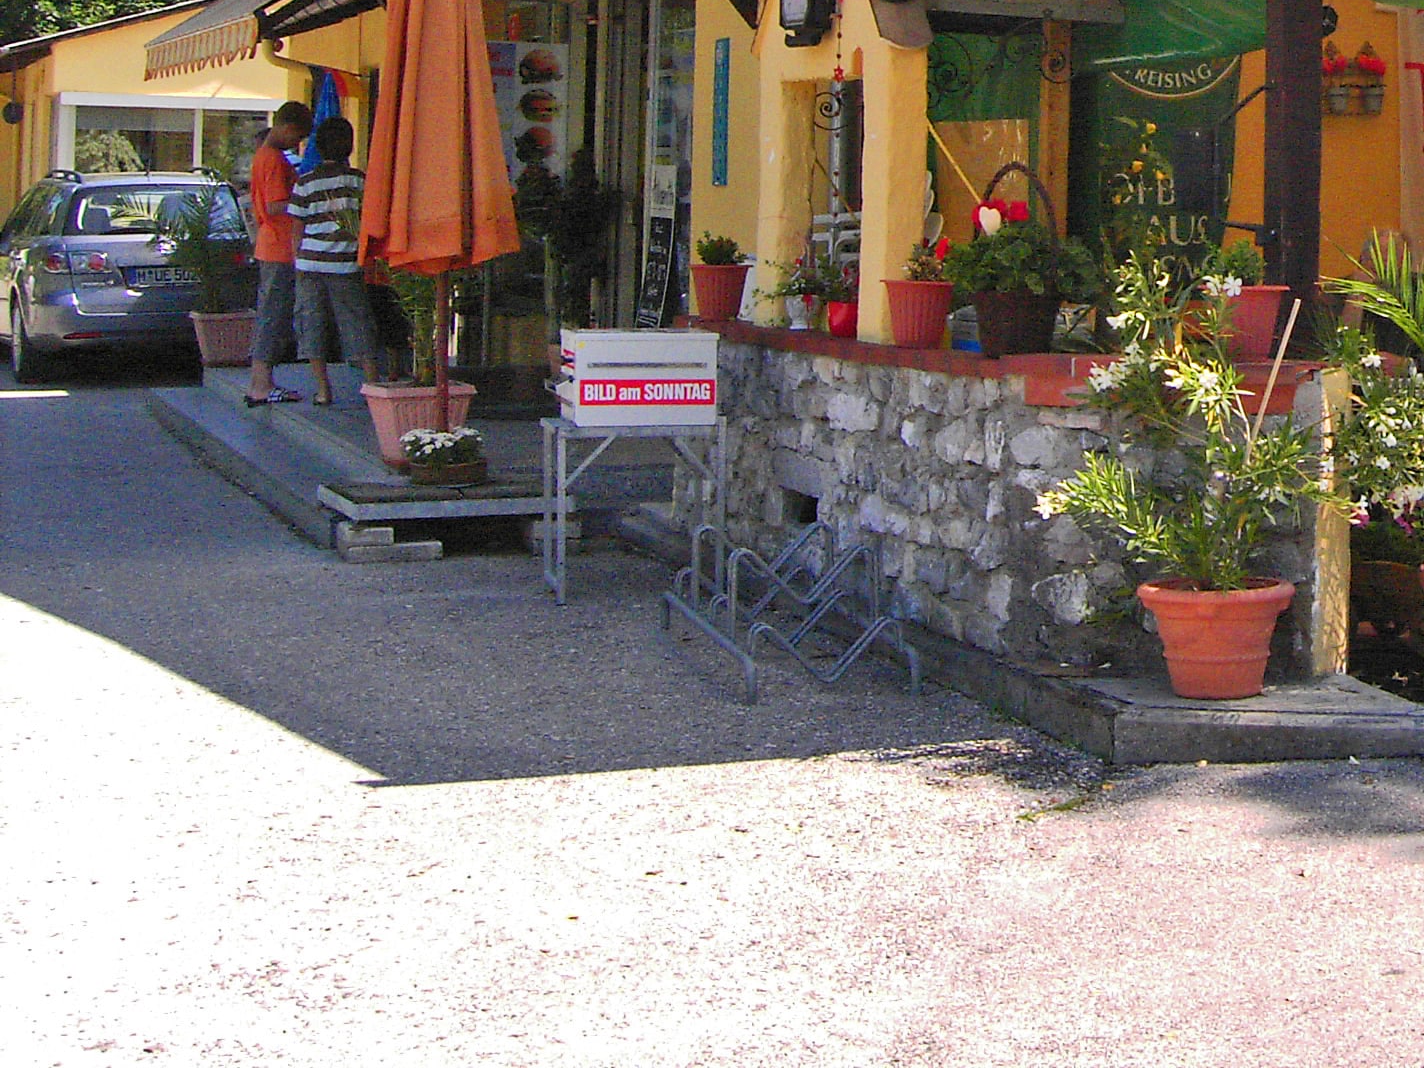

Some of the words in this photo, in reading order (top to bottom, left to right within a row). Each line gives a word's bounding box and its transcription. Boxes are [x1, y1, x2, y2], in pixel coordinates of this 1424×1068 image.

[1126, 63, 1212, 89] REISING
[583, 383, 617, 402] BILD
[618, 386, 641, 401] am
[643, 382, 712, 401] SONNTAG
